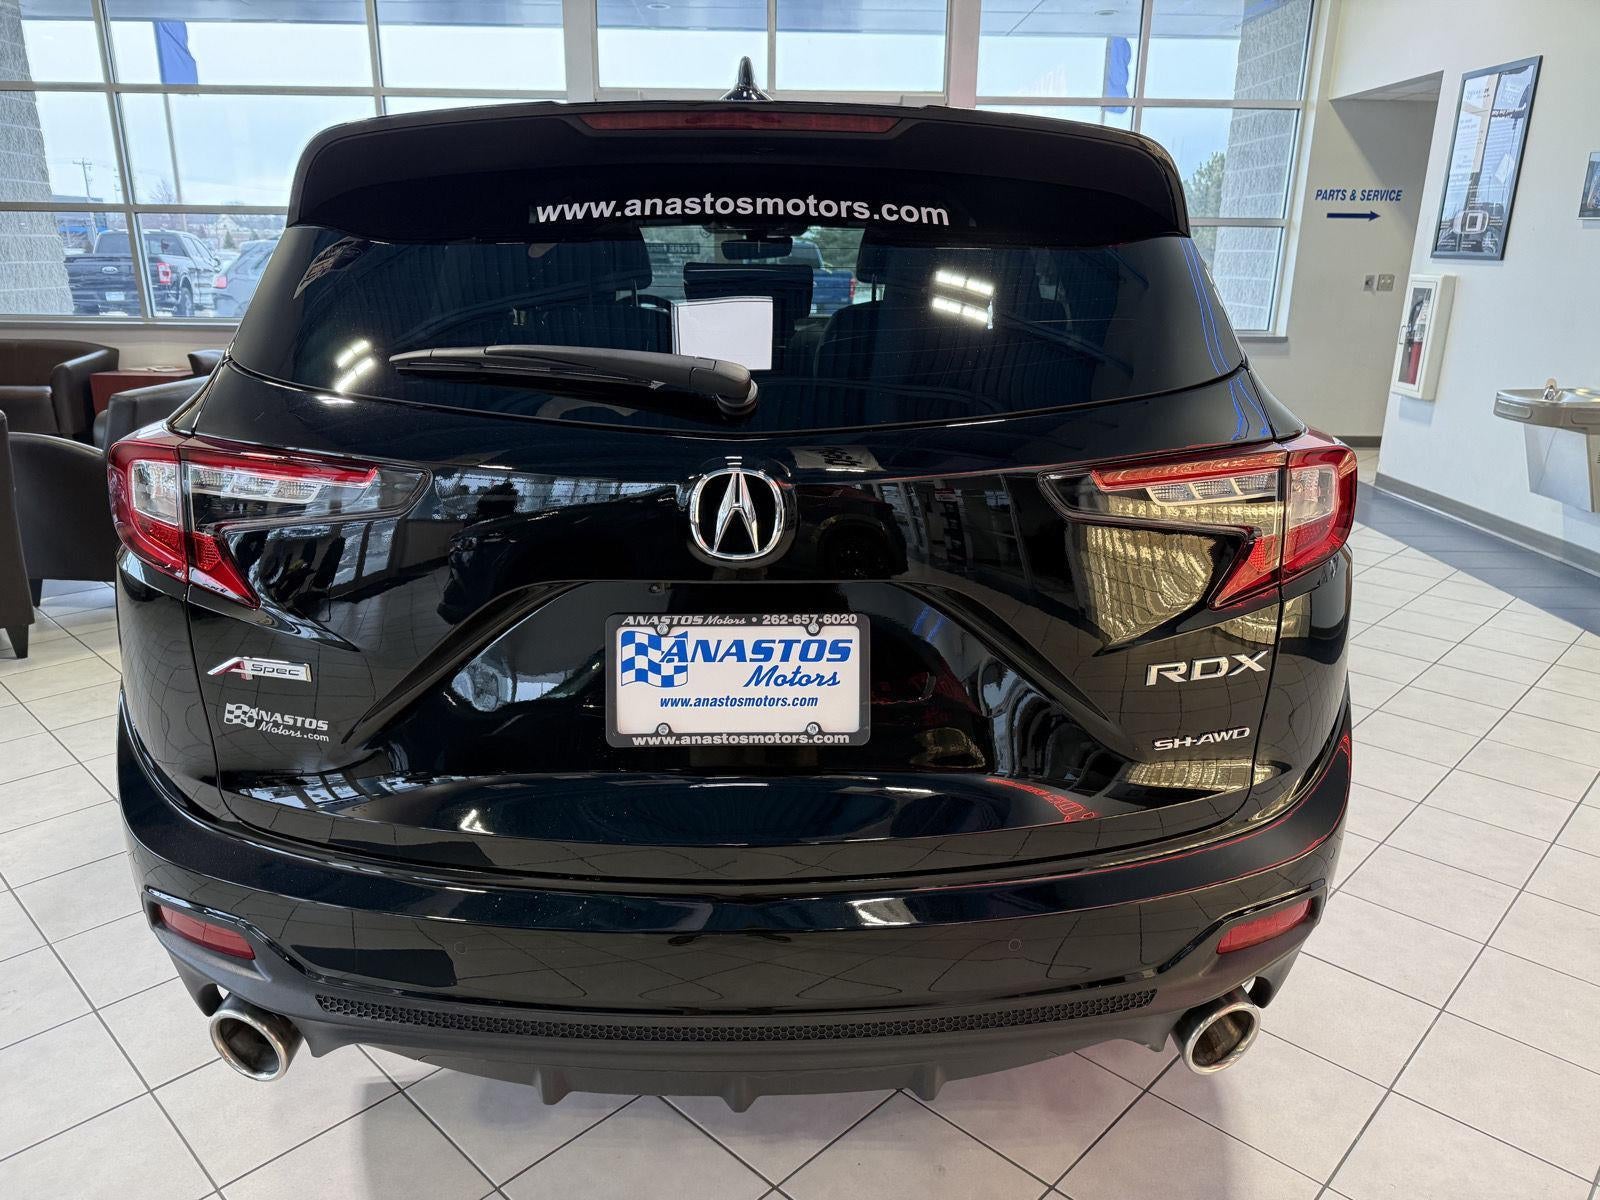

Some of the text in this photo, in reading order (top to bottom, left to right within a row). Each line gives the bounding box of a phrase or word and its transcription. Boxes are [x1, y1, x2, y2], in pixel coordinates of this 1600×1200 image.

[1315, 189, 1403, 201] PARTS & SERVICE
[536, 193, 950, 226] www.anastosmotors.com
[621, 614, 858, 625] ANASTOS Motors 262-657-6020
[659, 638, 853, 663] ANASTOS
[743, 665, 841, 688] Motors
[1145, 650, 1269, 686] RDX
[660, 695, 818, 708] www.anastosmotors.com
[246, 707, 329, 731] ANASTOS
[632, 733, 850, 746] www.anastosmotors.com
[1153, 727, 1250, 751] SH-AWD
